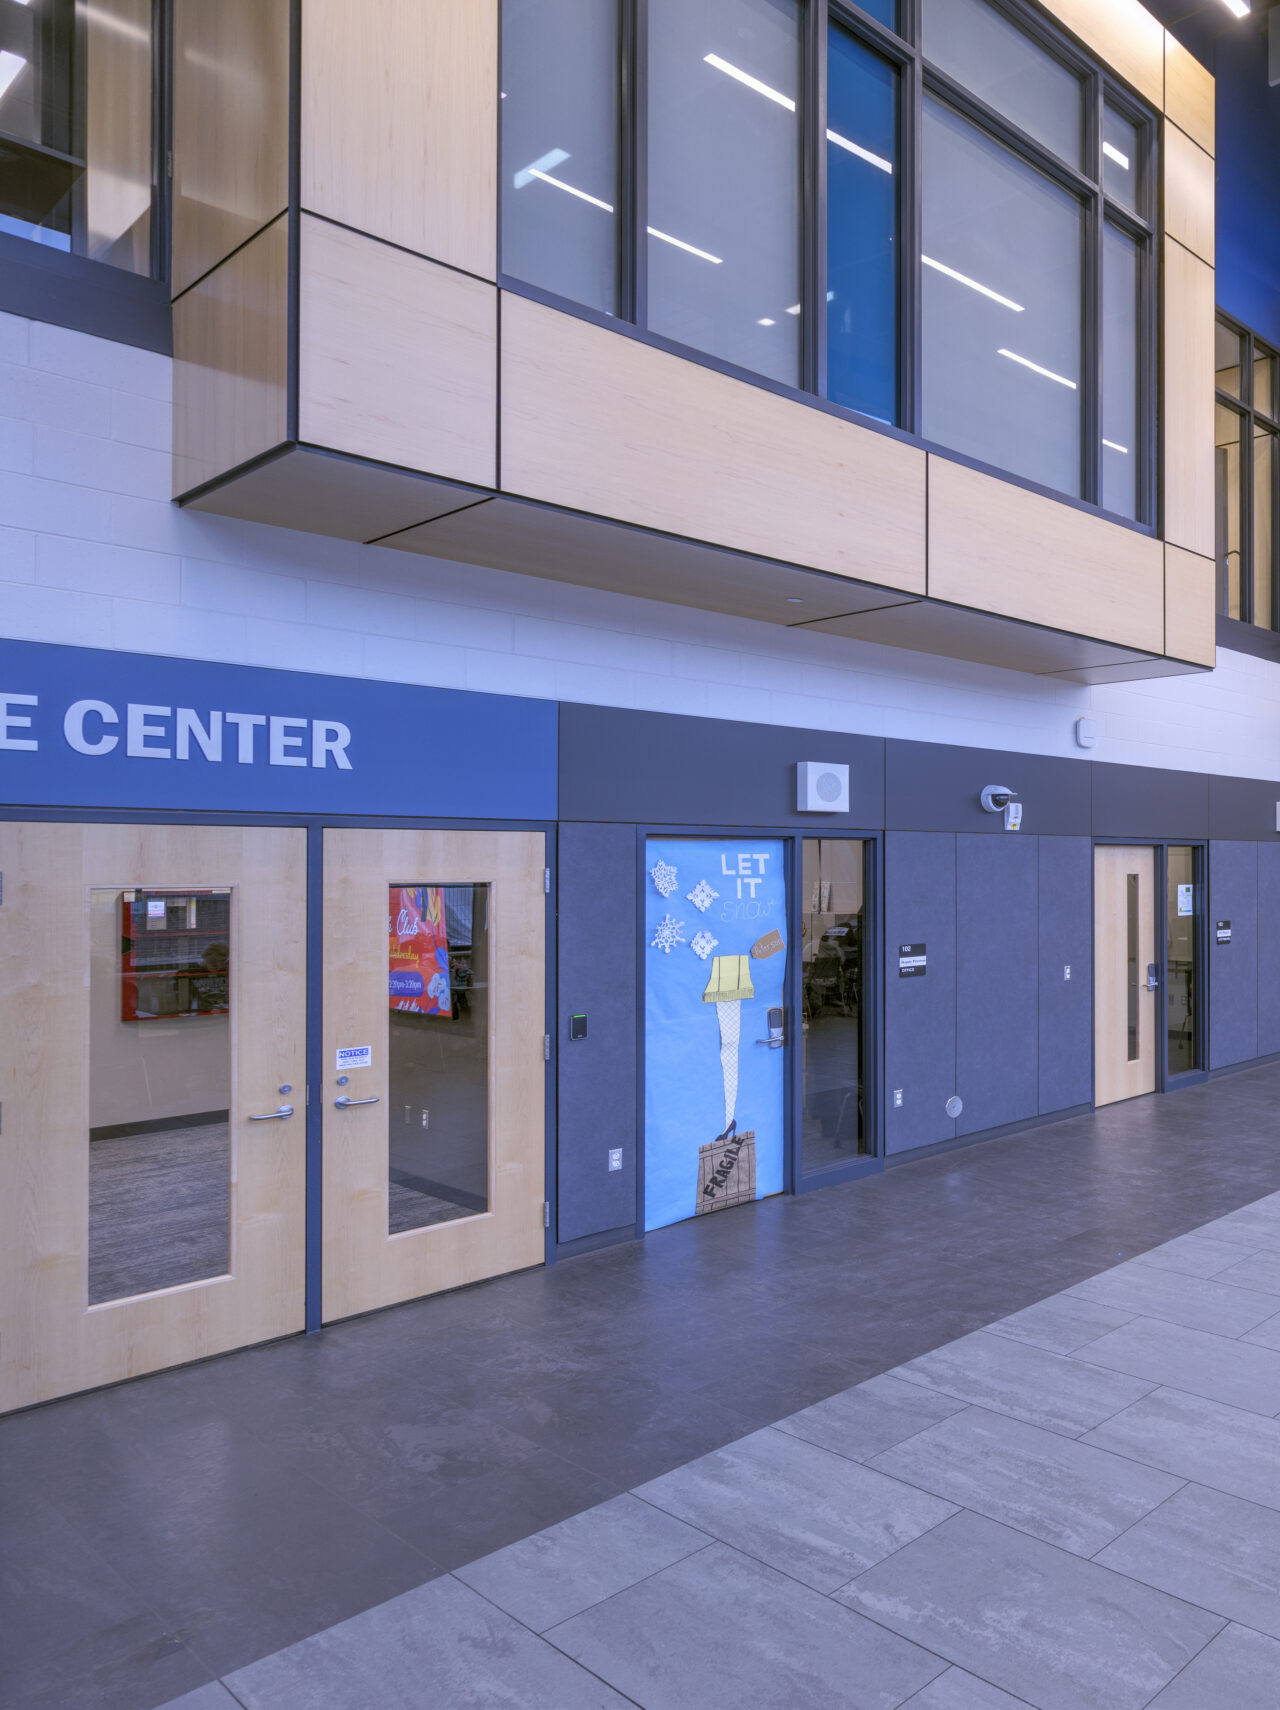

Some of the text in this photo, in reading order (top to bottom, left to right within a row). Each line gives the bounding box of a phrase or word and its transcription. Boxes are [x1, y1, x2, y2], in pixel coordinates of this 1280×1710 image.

[64, 699, 353, 770] CENTER
[721, 853, 770, 875] LET
[737, 877, 762, 899] IT
[396, 909, 419, 936] Club
[339, 1048, 369, 1058] NOTICE
[703, 1135, 745, 1198] FRAGILE
